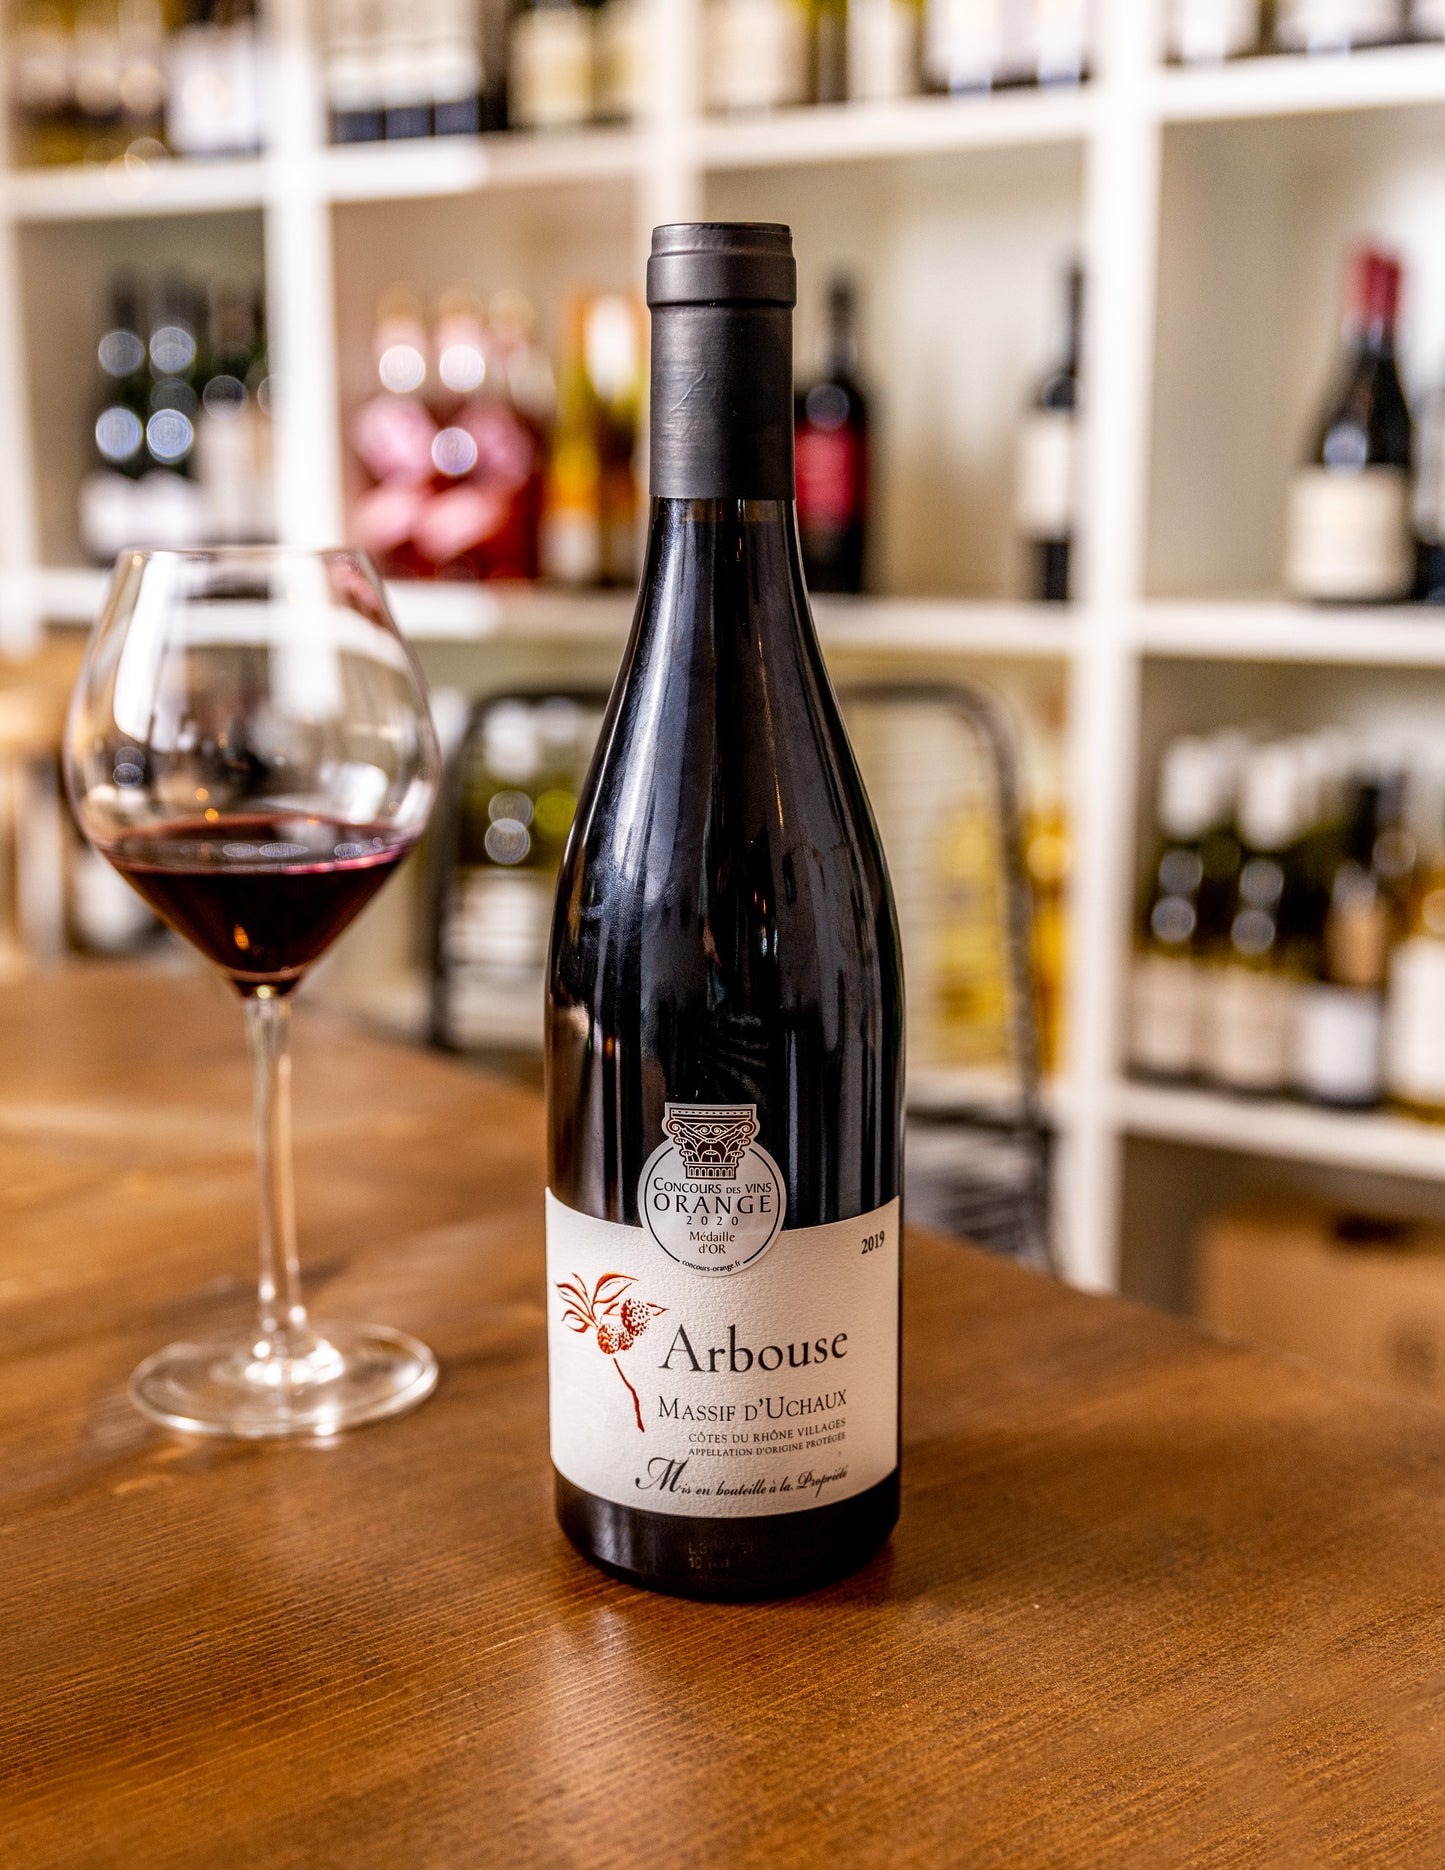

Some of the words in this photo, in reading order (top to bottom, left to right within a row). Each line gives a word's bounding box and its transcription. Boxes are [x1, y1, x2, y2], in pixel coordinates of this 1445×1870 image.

[653, 1177, 722, 1194] CONCOURS
[745, 1182, 772, 1194] VINS
[653, 1193, 772, 1214] ORANGE
[686, 1215, 739, 1226] 2020
[689, 1231, 736, 1242] Médaille
[861, 1230, 885, 1255] 2019
[698, 1243, 727, 1254] d'OR
[681, 1260, 741, 1272] concours-orange.fr
[658, 1323, 848, 1373] Arbouse
[658, 1395, 736, 1421] MASSIF
[745, 1389, 847, 1421] D'UCHAUX
[688, 1431, 728, 1444] CÔTES
[732, 1433, 749, 1444] DU
[753, 1429, 794, 1443] RHÔNE
[797, 1417, 847, 1437] VILLAGES
[688, 1448, 753, 1457] APPELLATION
[756, 1442, 804, 1455] D'ORIGINE
[634, 1457, 692, 1494] Mis
[696, 1487, 712, 1496] en
[715, 1479, 767, 1496] bouteille
[768, 1481, 777, 1493] à
